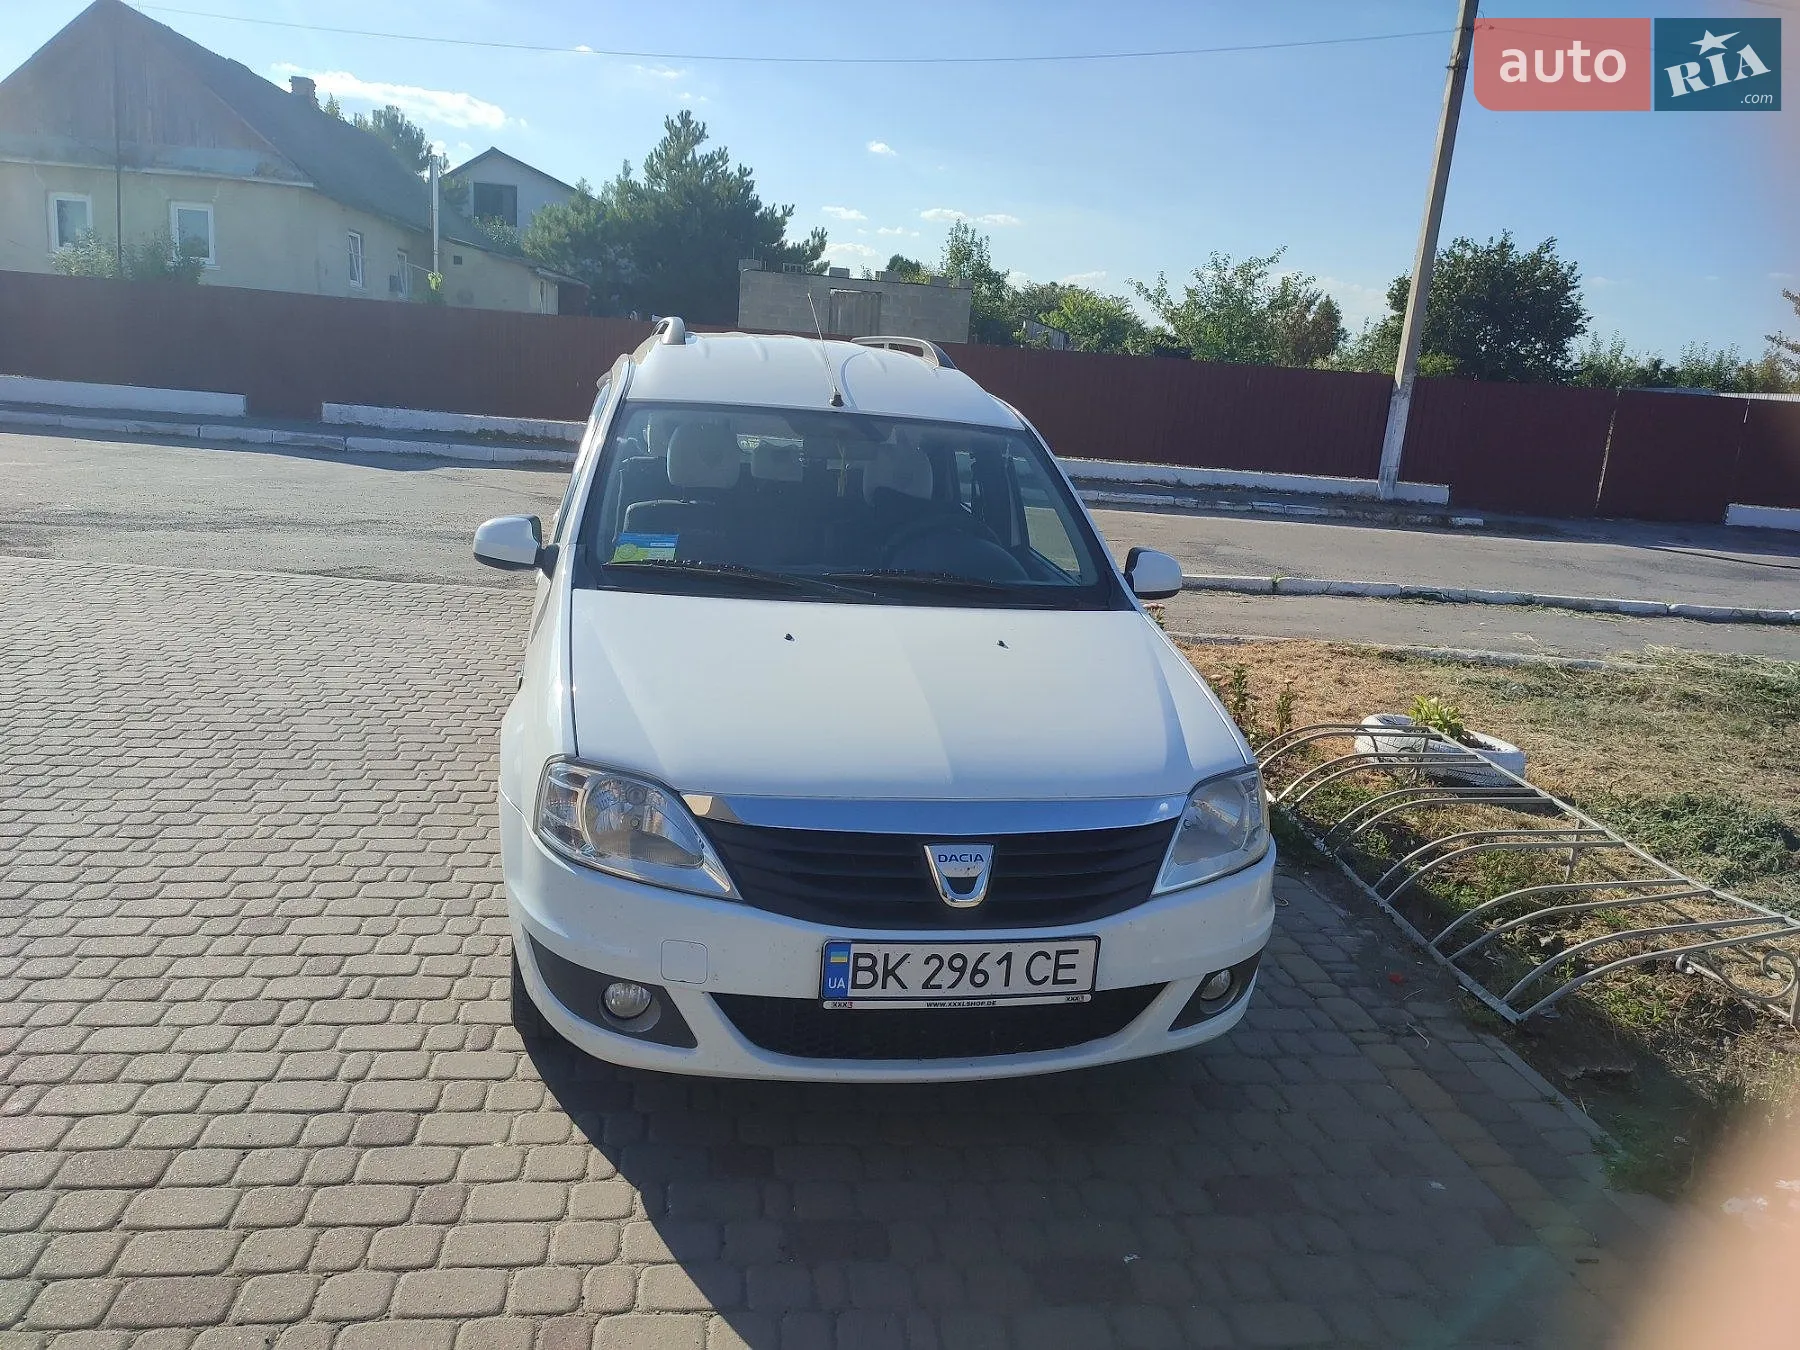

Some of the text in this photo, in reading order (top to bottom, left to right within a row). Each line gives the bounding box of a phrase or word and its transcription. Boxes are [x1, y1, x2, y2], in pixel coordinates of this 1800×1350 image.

[938, 853, 984, 863] DACIA
[850, 949, 1080, 990] BK 2961 CE
[828, 977, 846, 990] UA
